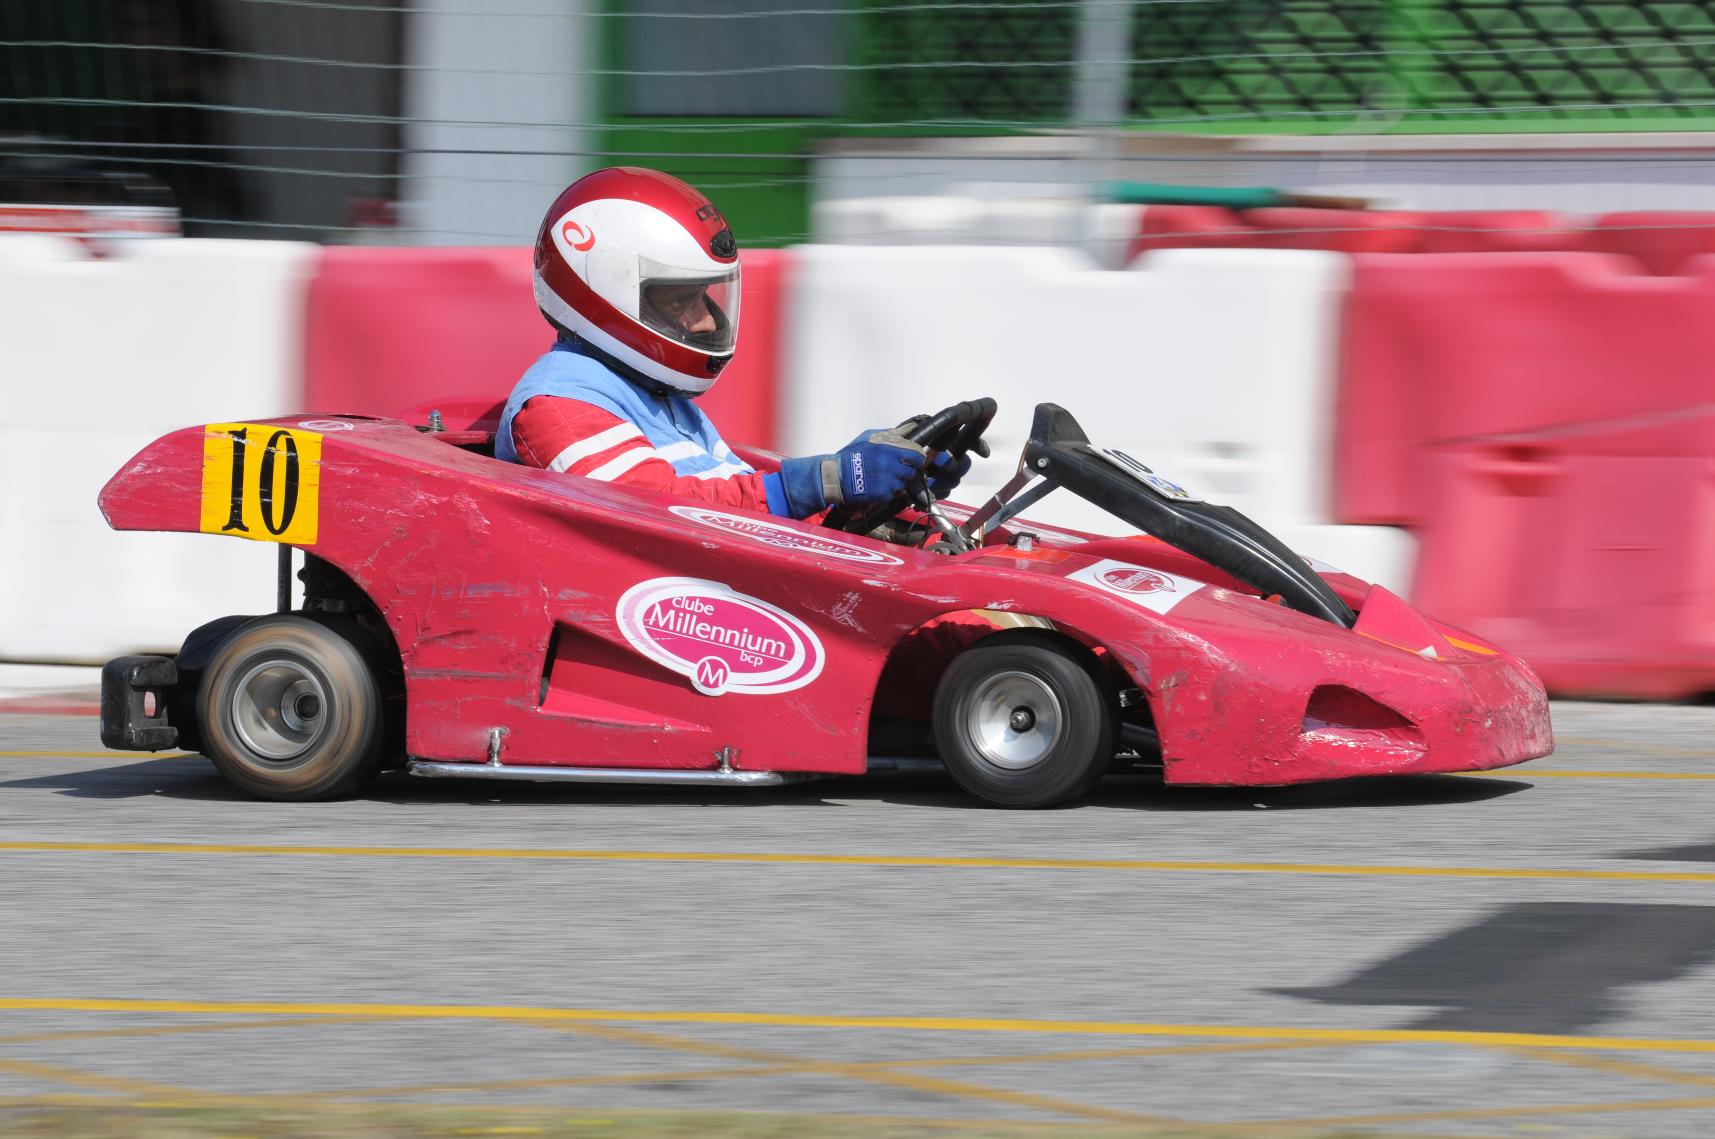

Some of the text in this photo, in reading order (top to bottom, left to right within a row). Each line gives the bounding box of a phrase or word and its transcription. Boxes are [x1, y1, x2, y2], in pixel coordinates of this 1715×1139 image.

[222, 427, 299, 535] 10
[852, 452, 864, 492] sparco
[707, 515, 861, 556] Millennium
[672, 596, 715, 616] clube
[649, 602, 786, 658] Millennium
[700, 661, 723, 687] M
[740, 651, 763, 667] bcp
